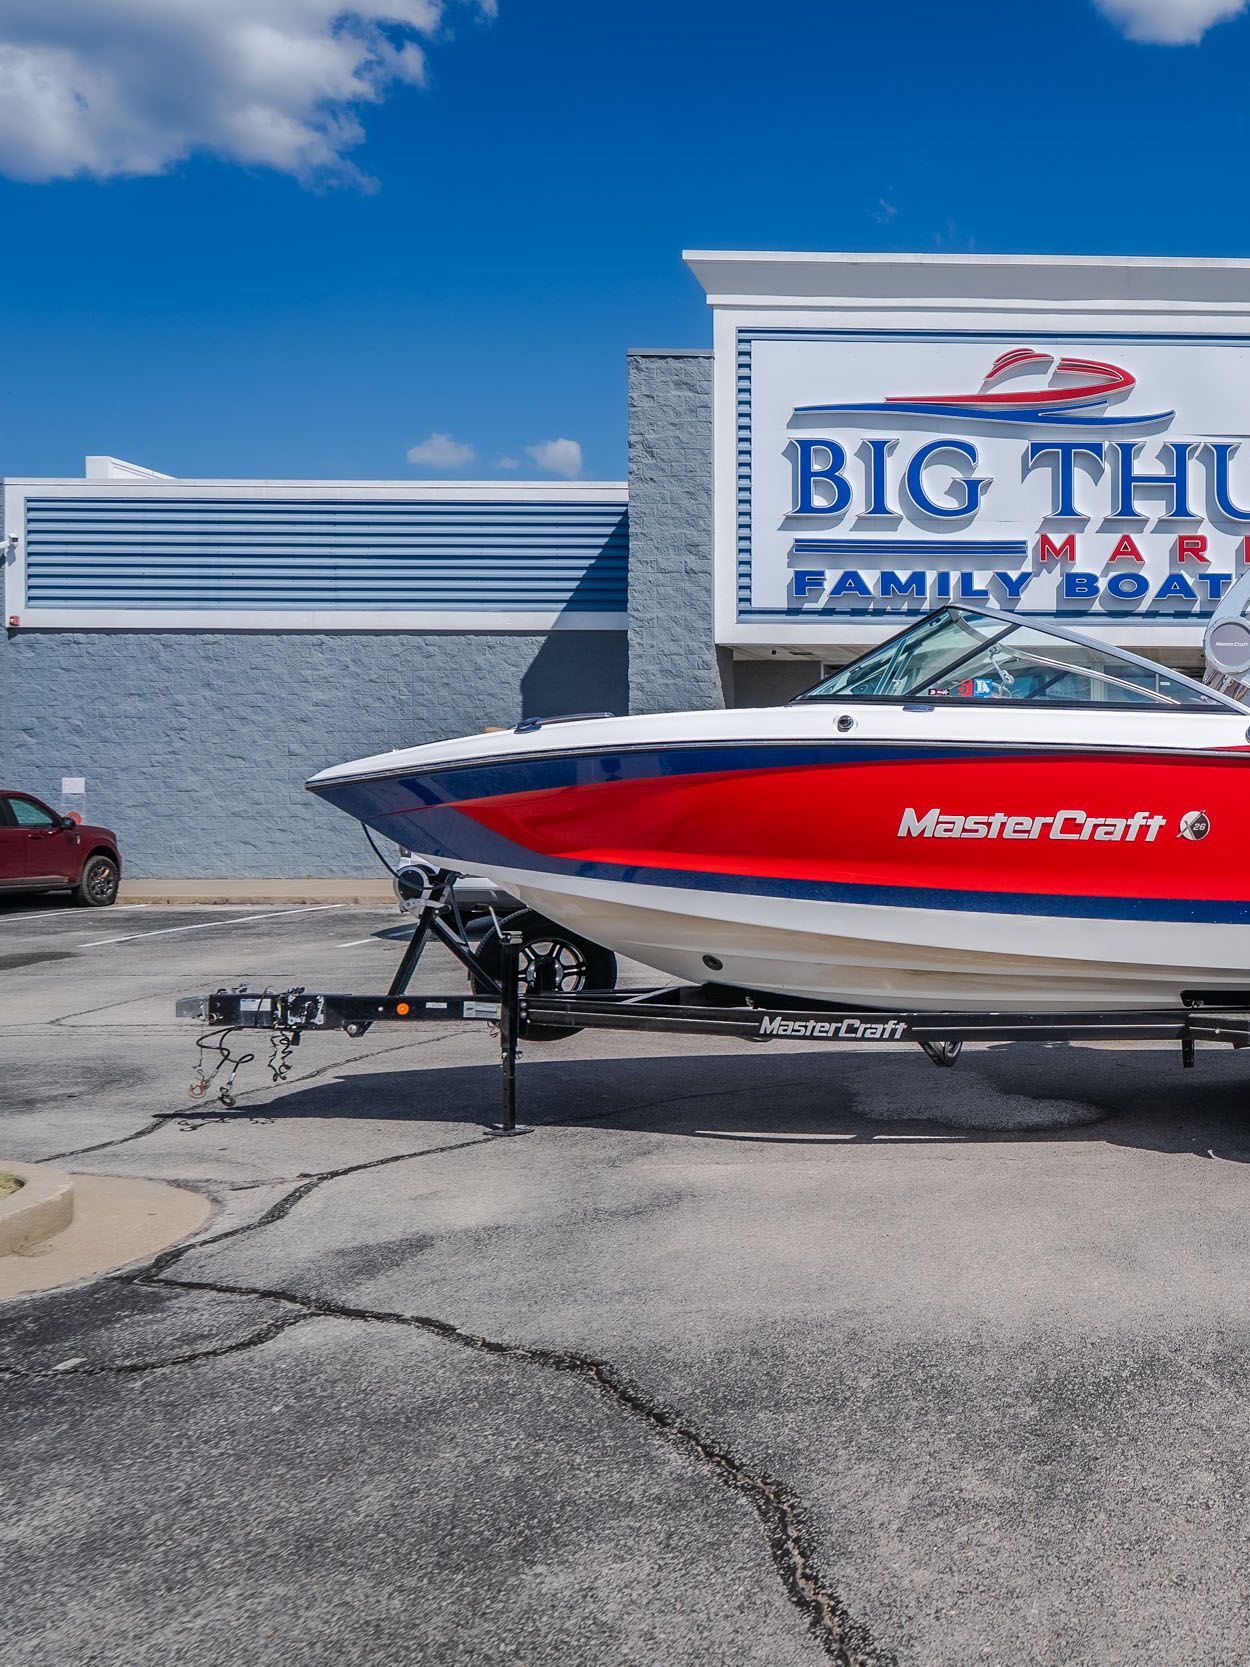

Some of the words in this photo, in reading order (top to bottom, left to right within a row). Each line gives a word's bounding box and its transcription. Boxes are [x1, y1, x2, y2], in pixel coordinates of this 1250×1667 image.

[783, 437, 994, 519] BIG
[793, 570, 1034, 600] FAMILY
[897, 808, 1167, 842] MasterCraft
[759, 1015, 908, 1039] MasterCraft
